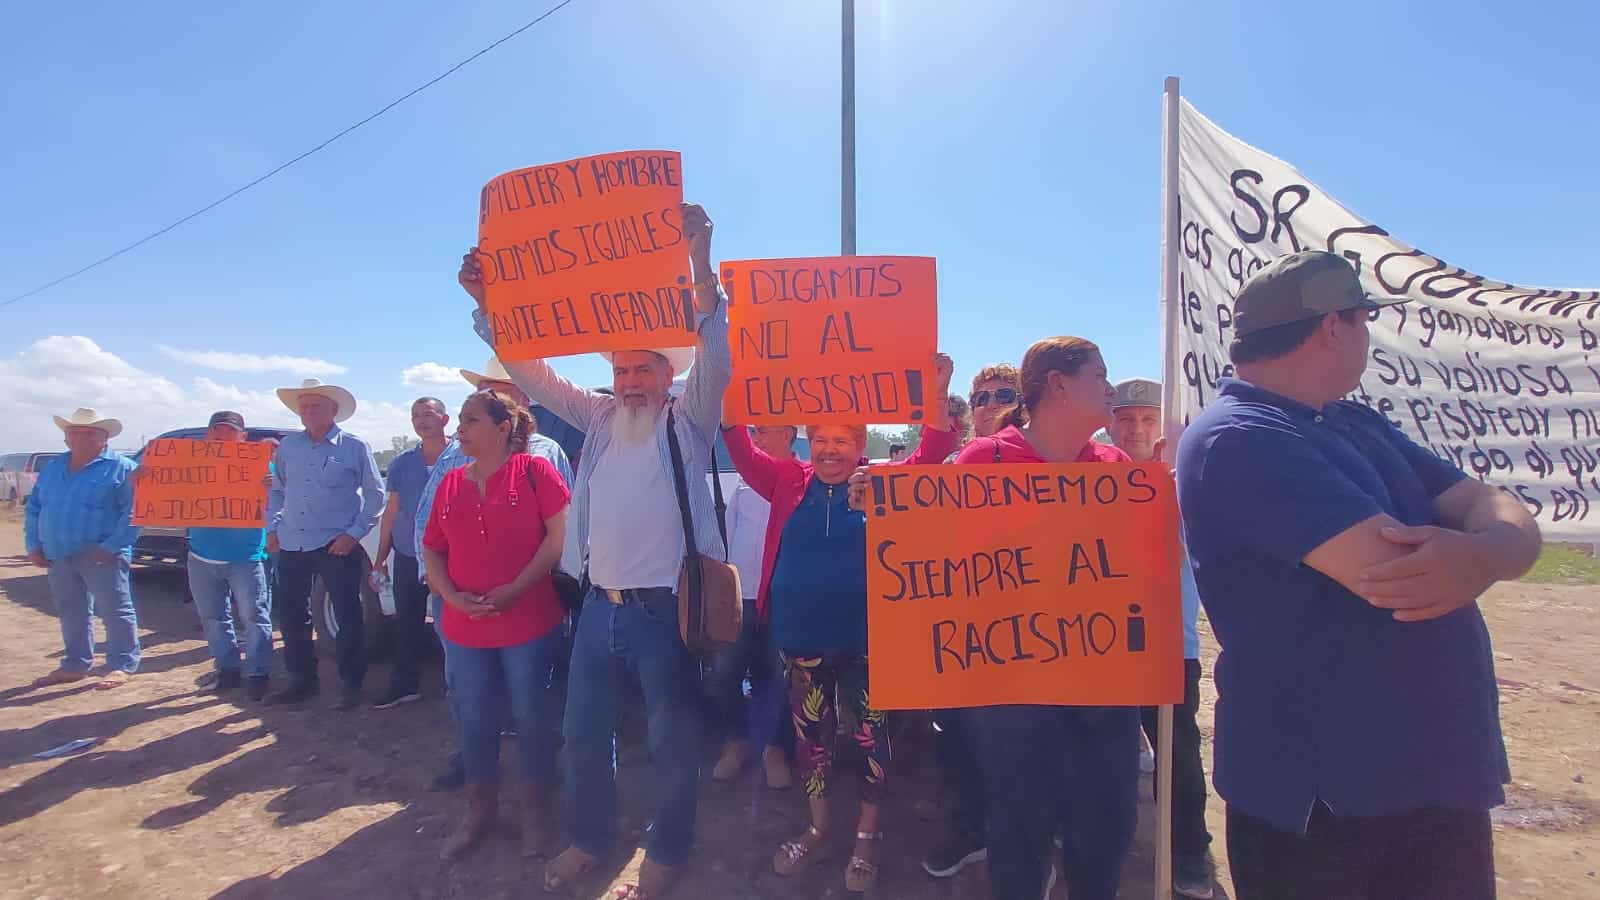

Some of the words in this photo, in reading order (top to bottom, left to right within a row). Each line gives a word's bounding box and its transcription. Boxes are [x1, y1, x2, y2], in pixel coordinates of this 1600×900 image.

[567, 159, 583, 198] Y
[591, 156, 680, 196] HOMBRE
[477, 229, 578, 286] SOMOS
[575, 208, 682, 266] IGUALES
[491, 303, 545, 346] ANTE
[551, 297, 590, 337] EL
[740, 319, 789, 361] NO
[820, 311, 873, 355] AL
[1418, 305, 1566, 350] ganaderos
[1424, 351, 1573, 396] valiosa
[1406, 395, 1551, 443] pisotear
[191, 440, 230, 459] PAZ
[236, 442, 261, 461] ES
[226, 463, 250, 484] DE
[135, 500, 157, 520] LA
[877, 539, 1041, 602] SIEMPRE
[1068, 537, 1129, 586] AL
